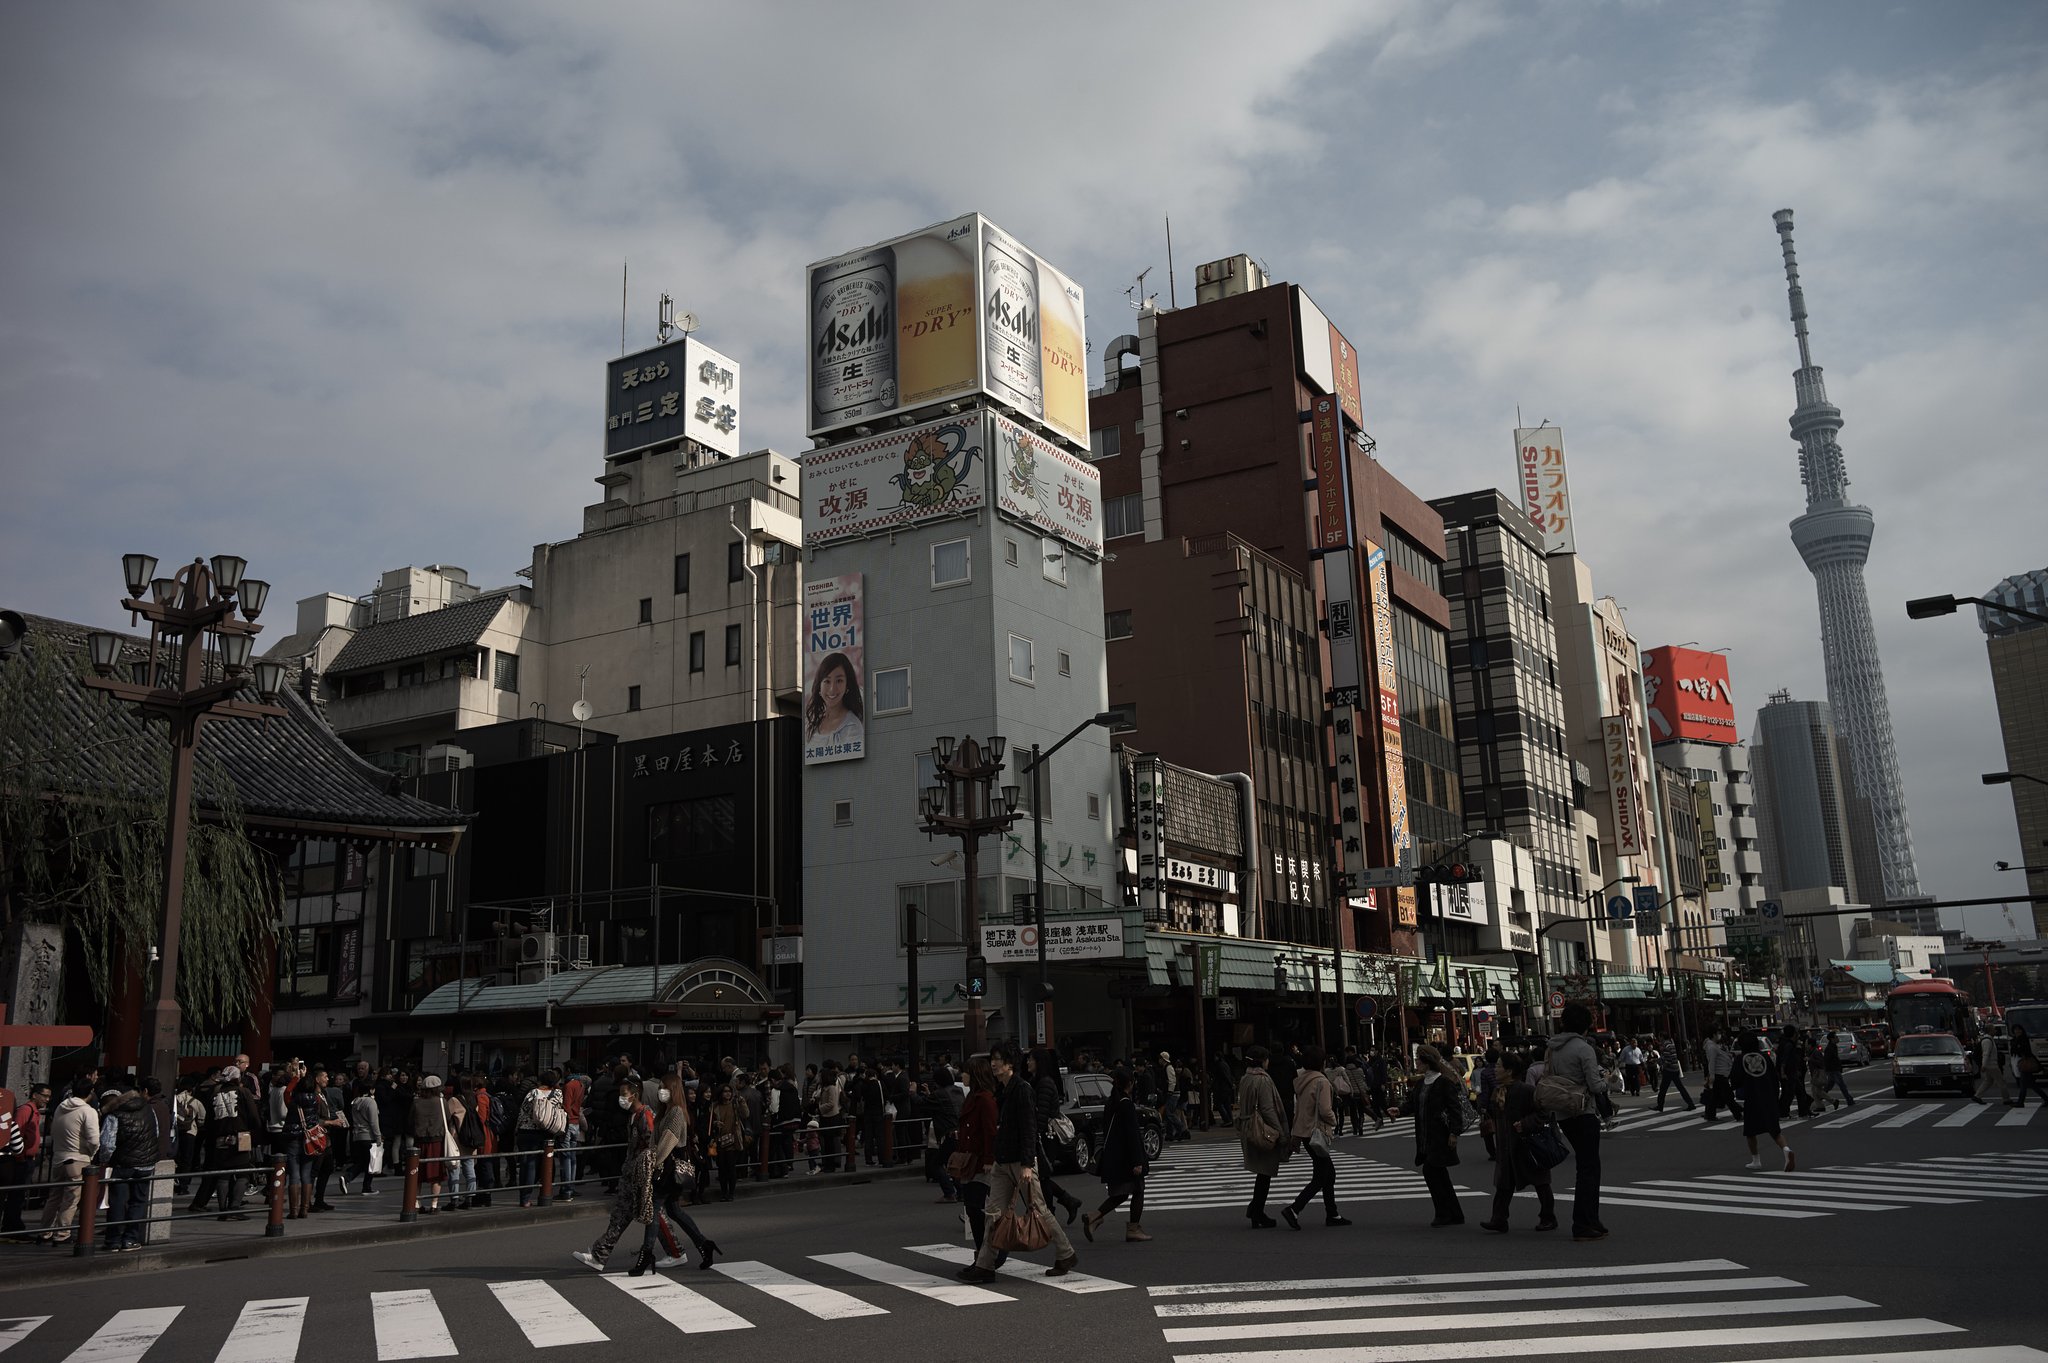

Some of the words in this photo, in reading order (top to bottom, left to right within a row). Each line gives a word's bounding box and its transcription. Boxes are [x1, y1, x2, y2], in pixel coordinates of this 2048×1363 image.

[946, 223, 972, 240] Asahi
[924, 303, 953, 318] SUPER
[988, 288, 1036, 345] Asahi
[816, 301, 889, 358] Asahi
[902, 307, 972, 338] "DRY"
[1007, 345, 1021, 367] 生
[622, 361, 670, 390] 天ぷら
[843, 363, 863, 381] 生
[833, 378, 874, 396] スーパードライ
[636, 392, 680, 424] 三定
[845, 408, 862, 419] 350ml
[1064, 472, 1085, 492] かぜに
[1320, 417, 1339, 527] 浅草タウンホテル
[829, 478, 857, 492] かぜに
[1522, 446, 1547, 534] SHIDAX
[1541, 445, 1569, 534] カラオケ
[819, 487, 868, 518] 改源
[1057, 483, 1092, 521] 改源
[830, 512, 858, 525] カイゲン
[1066, 512, 1086, 528] カイゲン
[1327, 530, 1343, 544] 5F
[808, 582, 833, 591] TOSHIBA
[811, 604, 852, 631] 世界
[1332, 603, 1351, 638] 和民
[812, 626, 855, 652] No.1
[1677, 677, 1733, 705] つぼ八
[1381, 694, 1392, 712] 5F
[806, 742, 861, 758] 太陽光は東芝
[1607, 722, 1627, 783] カラオケ
[1616, 786, 1634, 849] SHIDAX
[1449, 884, 1470, 913] 和民
[1400, 906, 1409, 921] B1
[986, 929, 1016, 940] 地下鉄
[1076, 924, 1109, 936] 浅草駅
[987, 940, 1016, 948] SUBWAY
[1076, 936, 1106, 944] Asakusa
[1107, 934, 1121, 942] Sta.
[774, 952, 796, 960] OBAN
